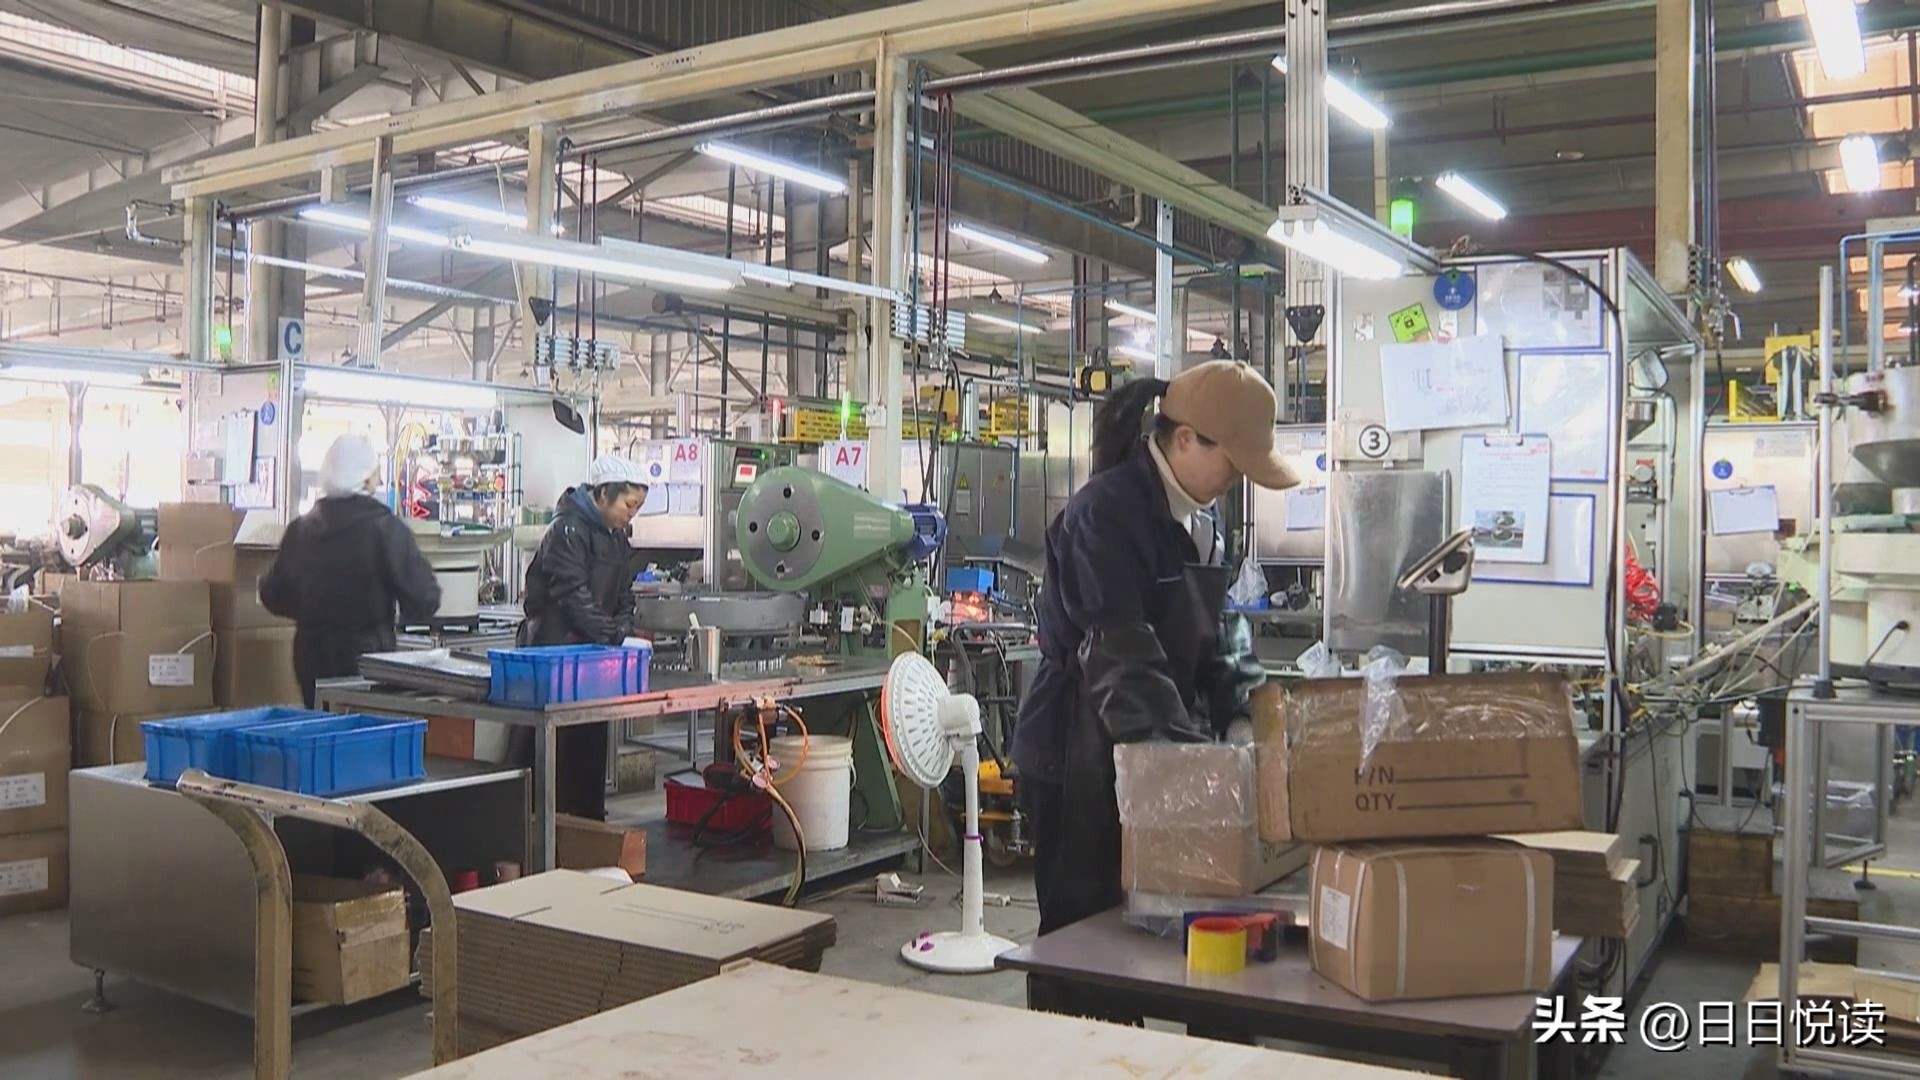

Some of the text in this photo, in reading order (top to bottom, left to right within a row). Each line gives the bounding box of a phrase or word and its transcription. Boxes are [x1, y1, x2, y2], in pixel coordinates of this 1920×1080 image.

[284, 320, 302, 354] C
[674, 444, 698, 462] A8
[836, 447, 861, 466] A7
[1355, 792, 1395, 812] QTY
